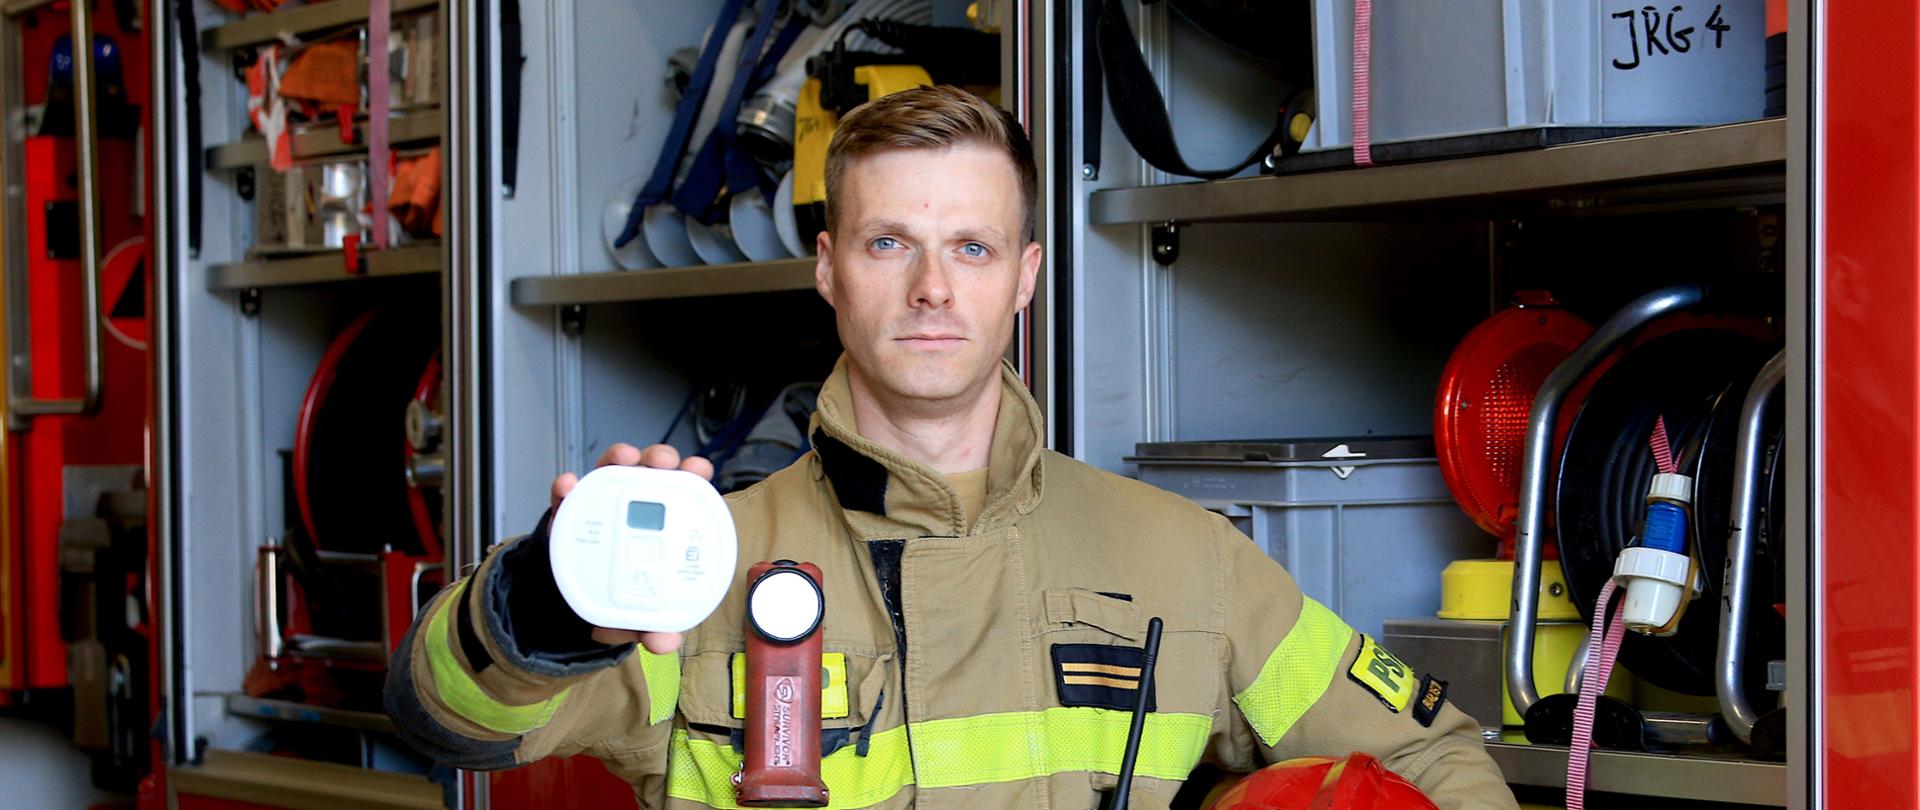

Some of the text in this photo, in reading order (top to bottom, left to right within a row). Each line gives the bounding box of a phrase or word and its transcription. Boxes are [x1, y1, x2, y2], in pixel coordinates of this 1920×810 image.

[1611, 4, 1731, 70] JRG 4
[782, 705, 791, 761] SURVIVOR
